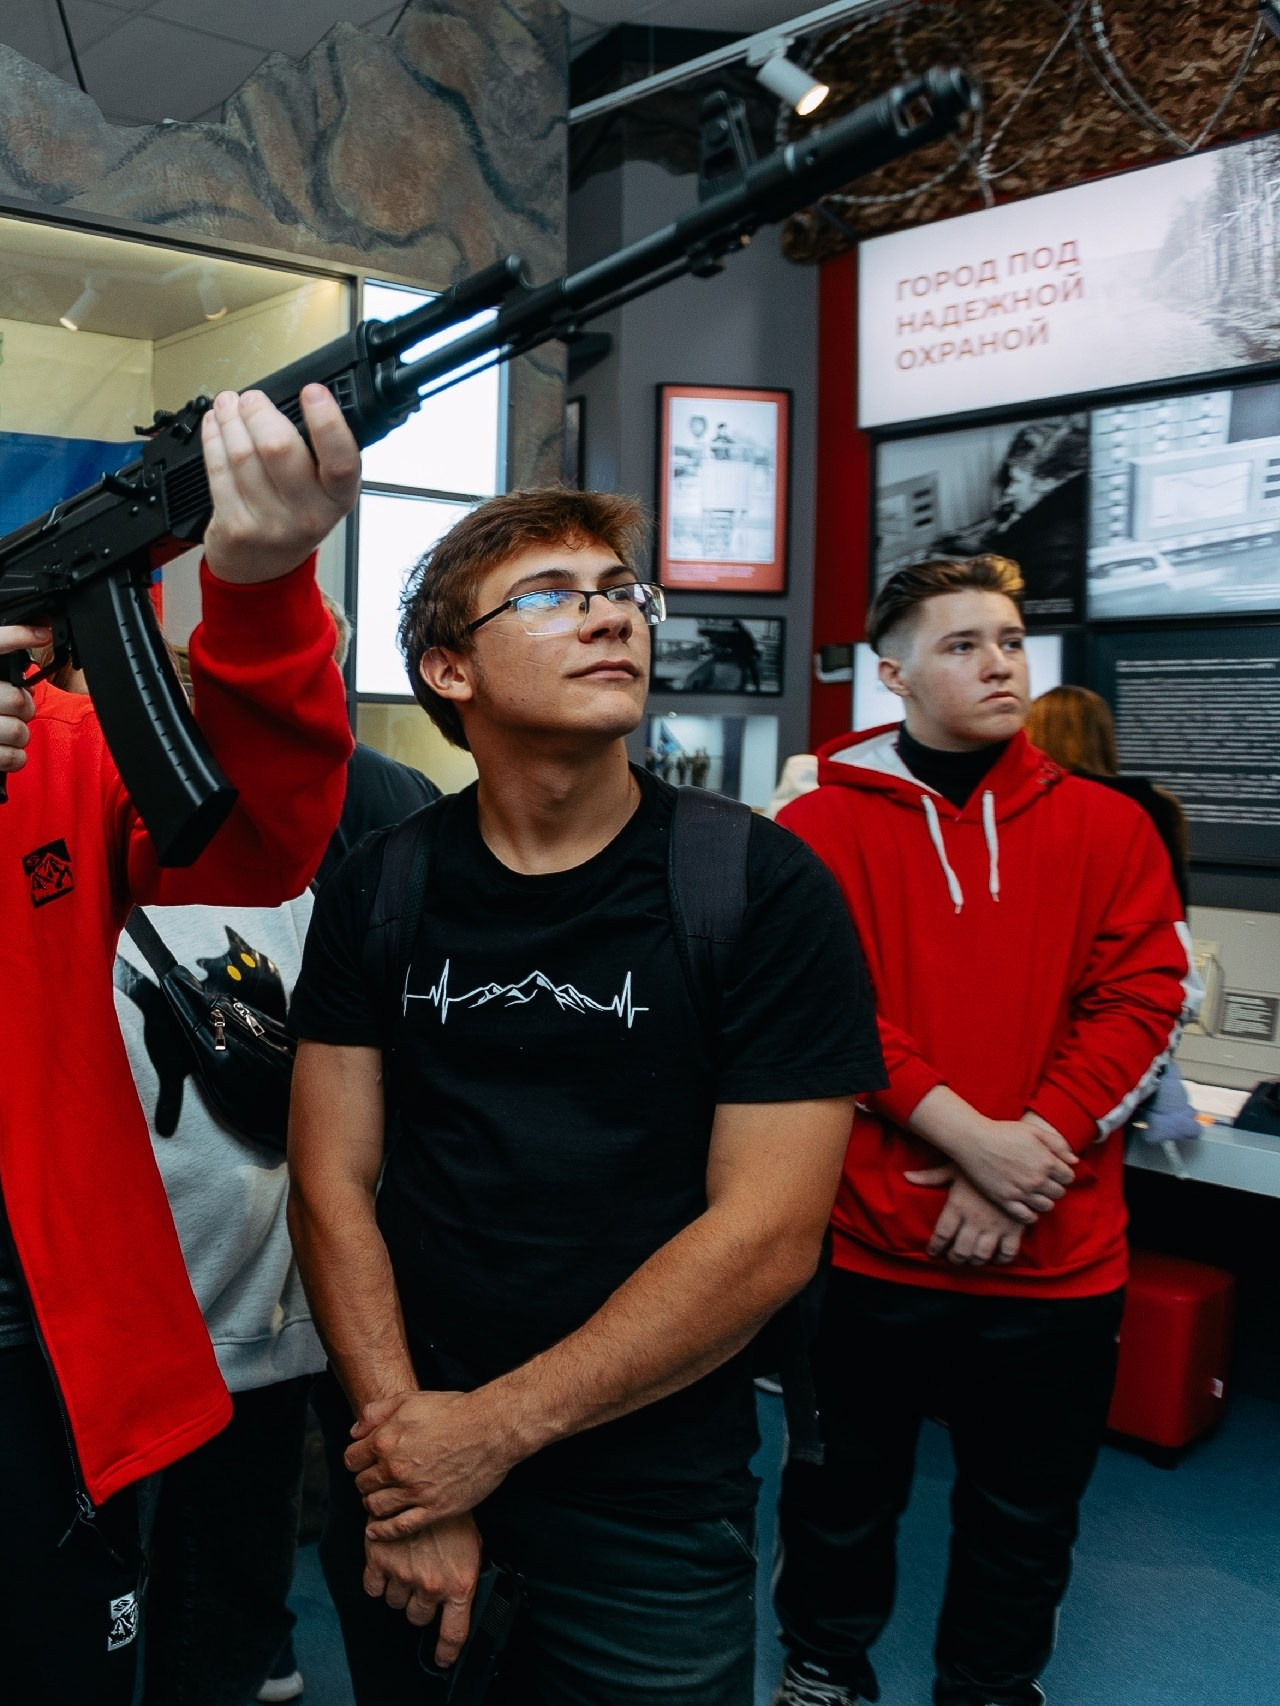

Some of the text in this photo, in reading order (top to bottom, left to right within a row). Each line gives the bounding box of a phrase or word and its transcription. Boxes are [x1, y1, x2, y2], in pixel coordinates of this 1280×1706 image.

[896, 240, 1081, 300] ГОРОД ПОД
[896, 271, 1084, 335] НАДЕЖНОЙ
[896, 316, 1050, 370] ОХРАНОЙ
